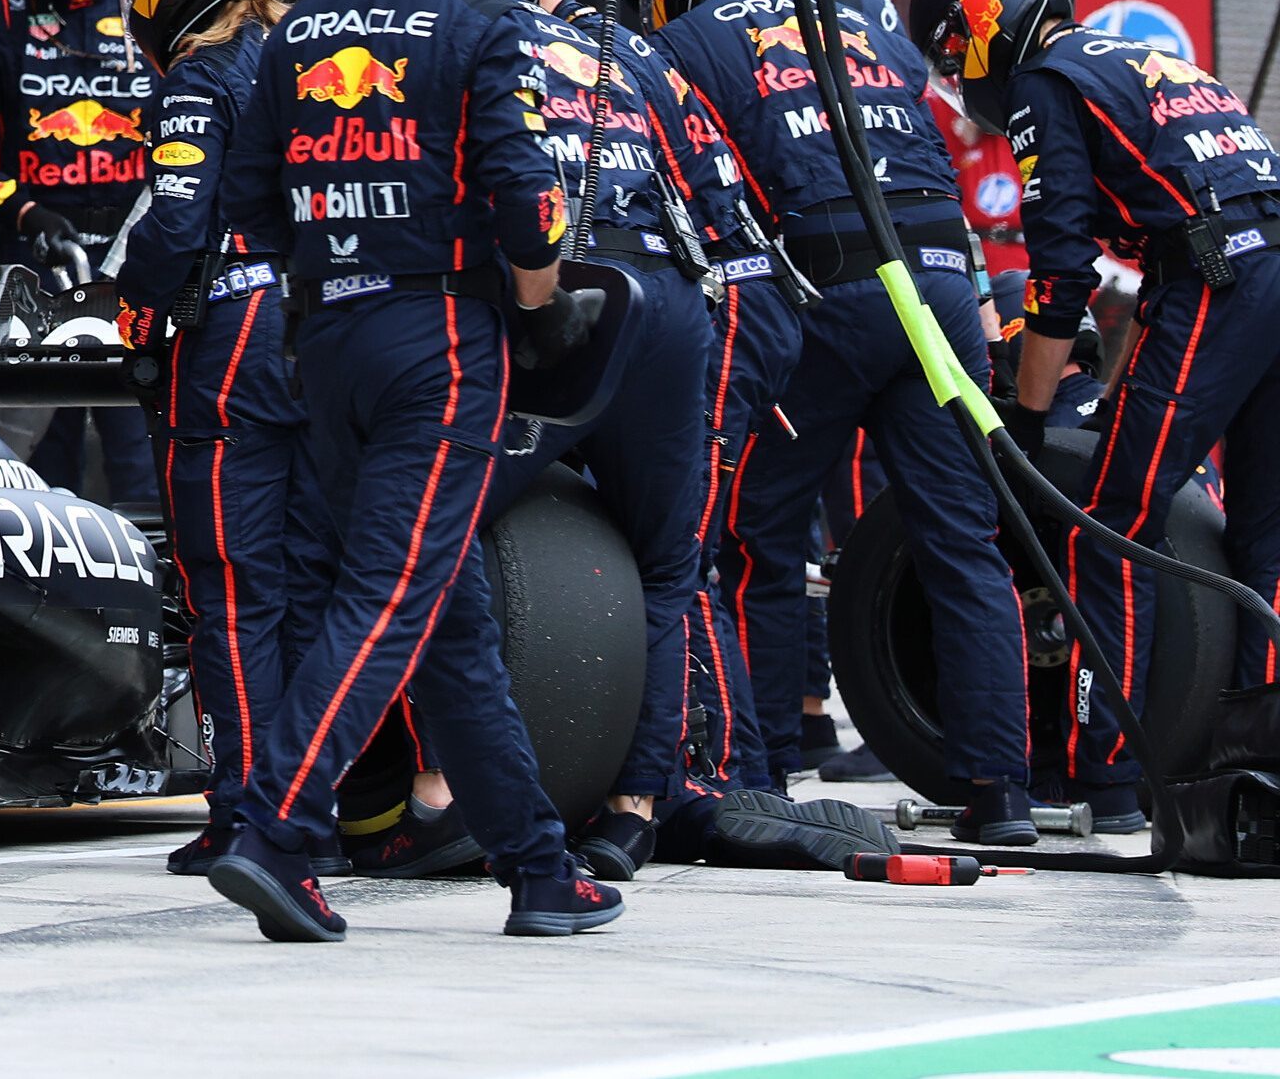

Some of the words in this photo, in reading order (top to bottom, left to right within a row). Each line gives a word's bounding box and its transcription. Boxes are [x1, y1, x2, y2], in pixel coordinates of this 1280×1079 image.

[285, 8, 440, 45] ORACLE
[18, 72, 153, 98] ORACLE
[159, 114, 212, 139] ROKT
[341, 117, 423, 163] Bull
[1183, 123, 1261, 163] Mobil
[18, 149, 88, 187] Red
[90, 145, 147, 186] Bull
[290, 182, 368, 223] Mobil
[322, 275, 390, 299] sparco
[106, 626, 139, 645] SIEMENS
